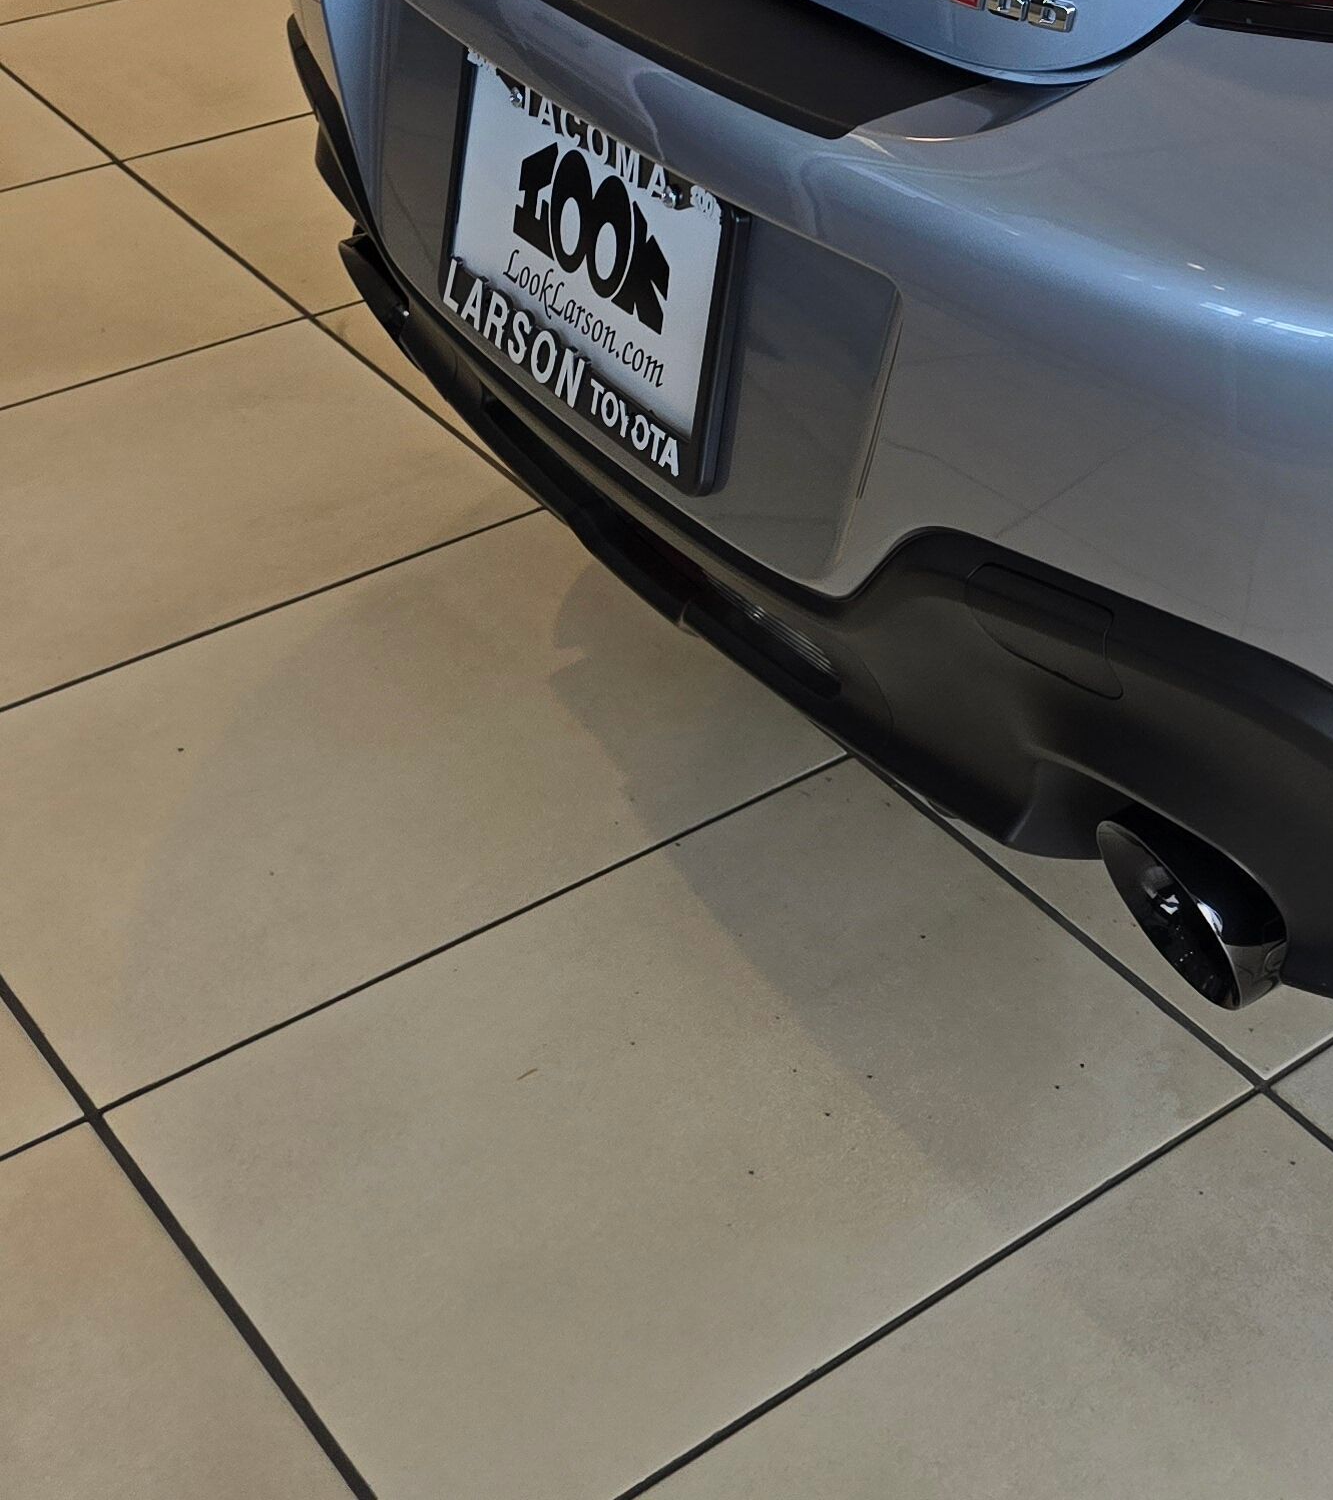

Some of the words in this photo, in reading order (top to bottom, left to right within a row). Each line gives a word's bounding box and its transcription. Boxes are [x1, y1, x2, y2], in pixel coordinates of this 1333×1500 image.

[502, 249, 665, 388] LookLarson.com
[512, 141, 671, 336] LOOK
[442, 258, 593, 409] LARSON
[590, 380, 681, 477] TOYOTA
